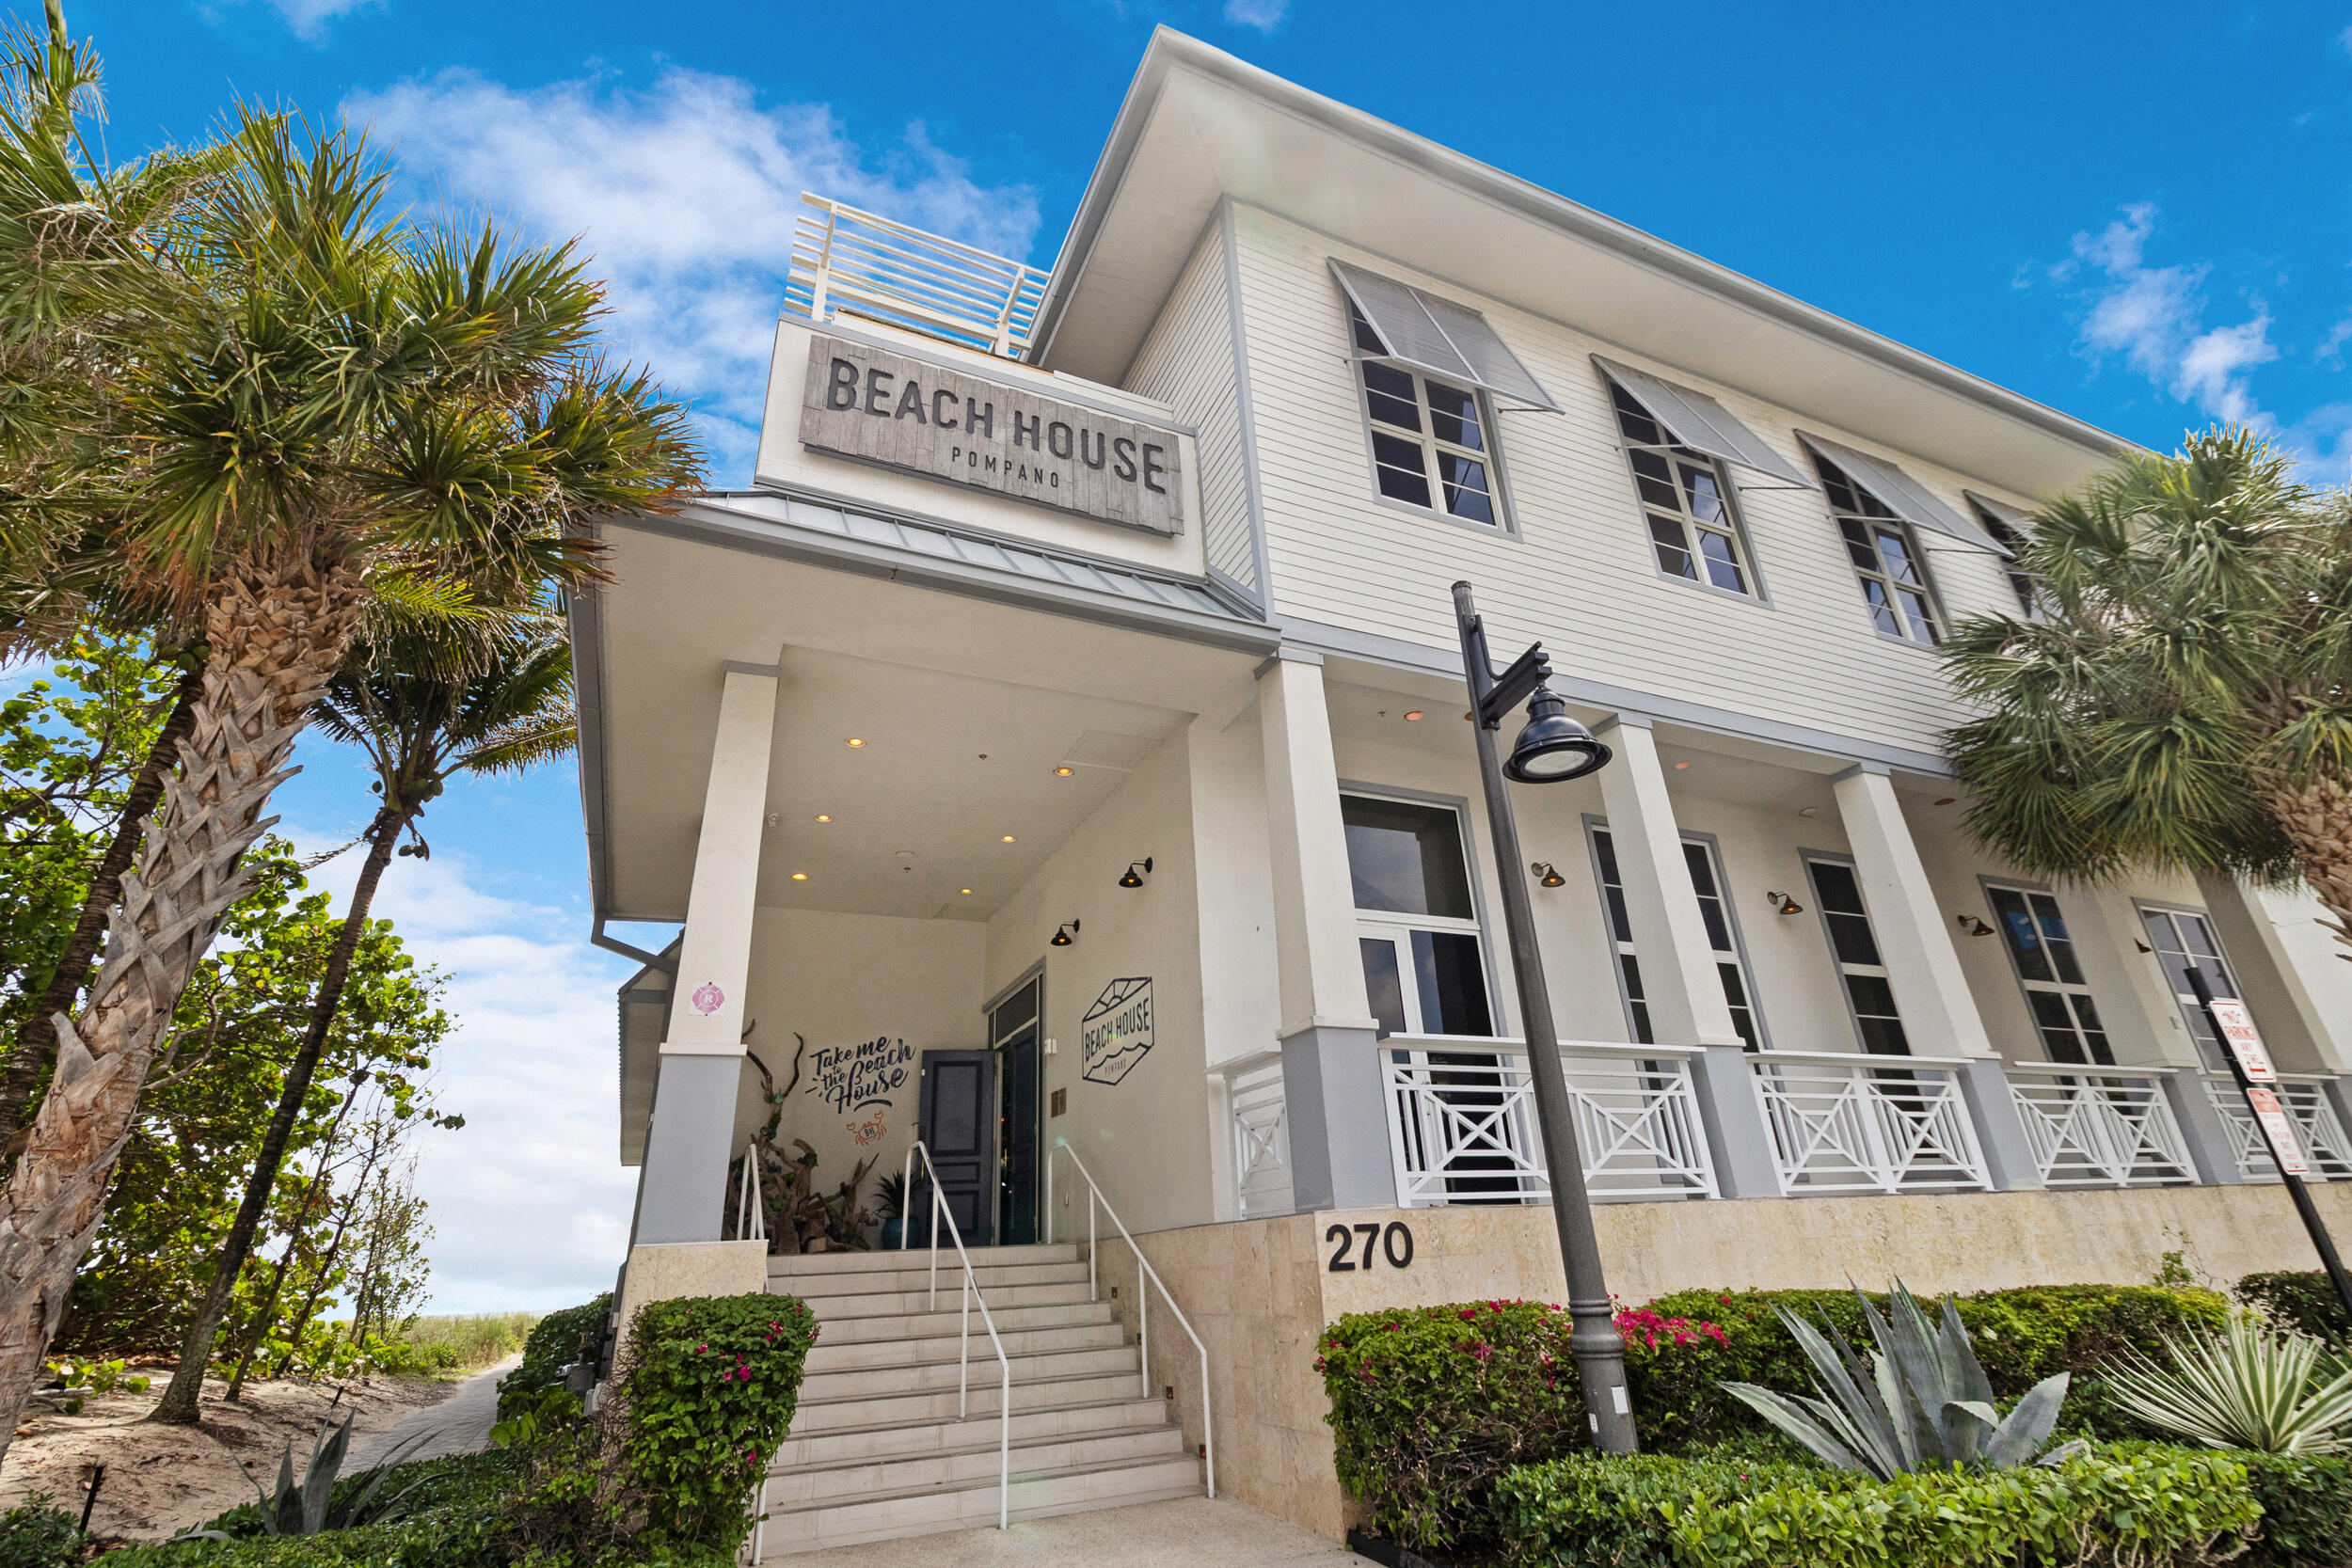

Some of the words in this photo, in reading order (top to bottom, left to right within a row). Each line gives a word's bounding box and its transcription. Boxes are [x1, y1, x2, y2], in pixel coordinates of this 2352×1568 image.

[826, 356, 994, 439] BEACH
[1013, 409, 1167, 495] HOUSE
[951, 446, 1059, 488] POMPANO
[1085, 1020, 1113, 1063] BEACH
[1116, 997, 1150, 1039] HOUSE
[809, 1046, 855, 1076] Take
[855, 1036, 892, 1060] me
[820, 1071, 849, 1091] the
[849, 1038, 916, 1087] Beach
[832, 1065, 842, 1075] to
[1104, 1057, 1126, 1076] POMPANO
[825, 1068, 910, 1115] House
[864, 1126, 875, 1137] BH
[1326, 1221, 1414, 1272] 270
